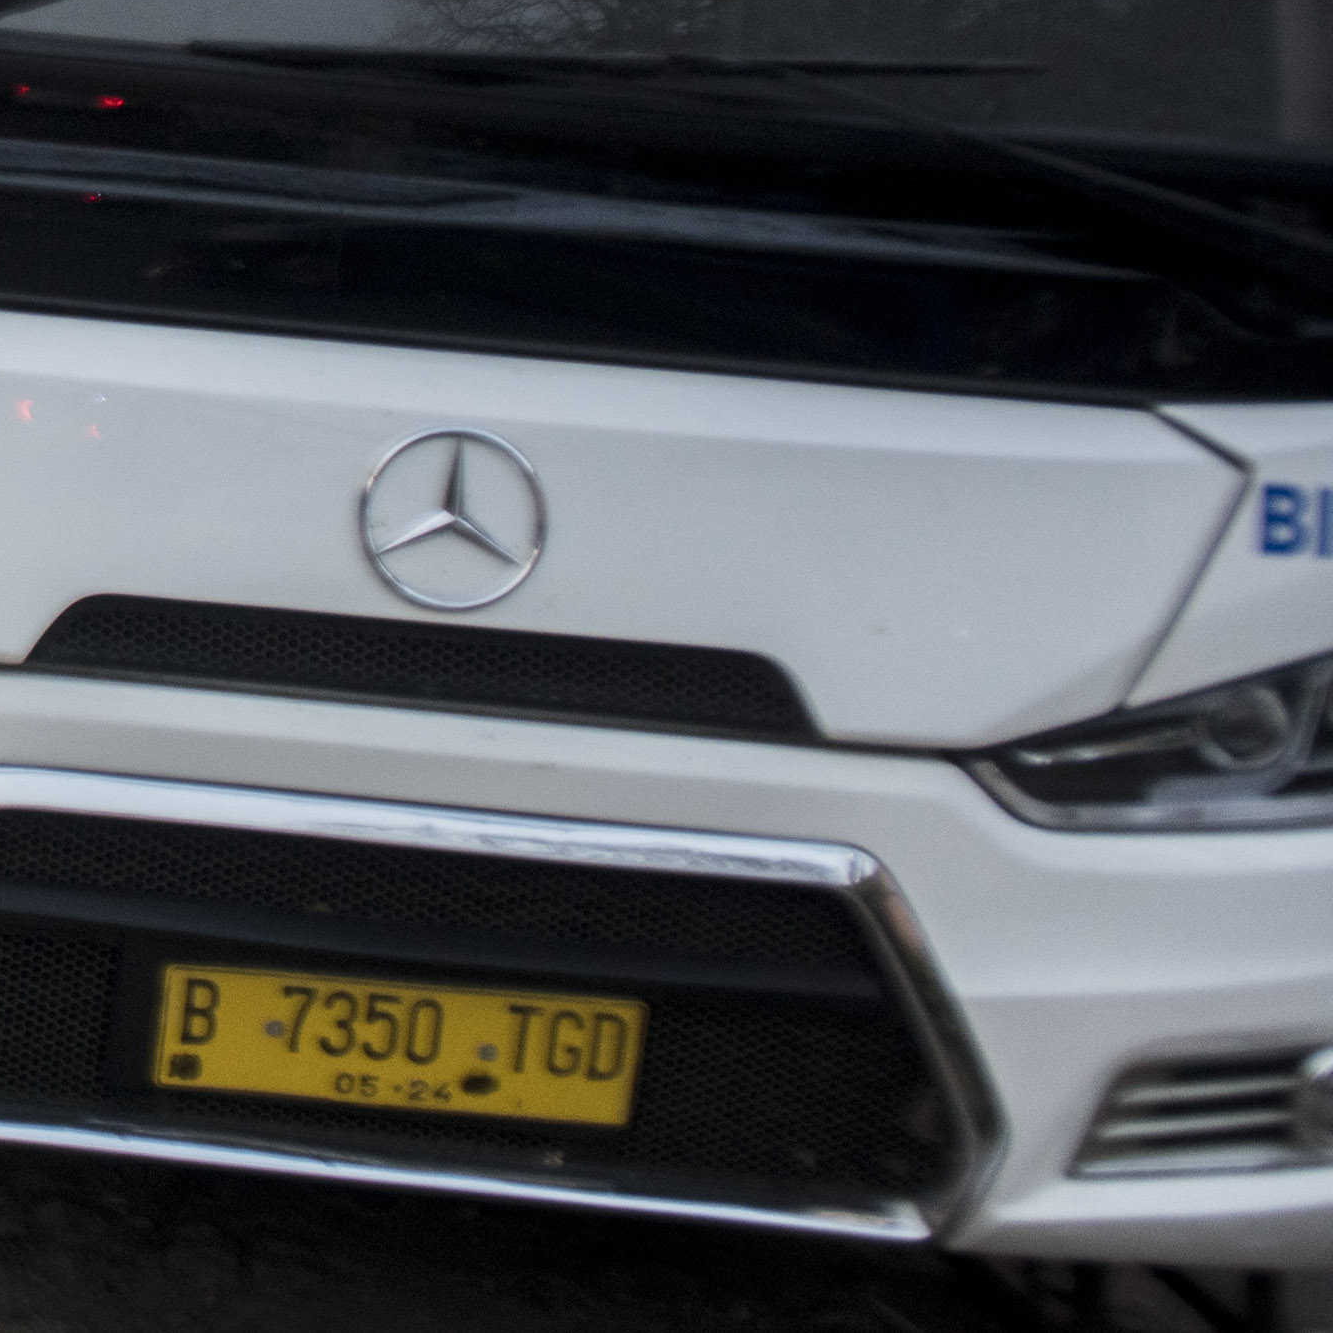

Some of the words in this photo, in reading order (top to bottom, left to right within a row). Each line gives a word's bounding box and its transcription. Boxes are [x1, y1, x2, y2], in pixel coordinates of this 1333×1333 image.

[180, 978, 221, 1046] B
[281, 985, 445, 1066] 7350
[507, 1005, 629, 1082] TGD
